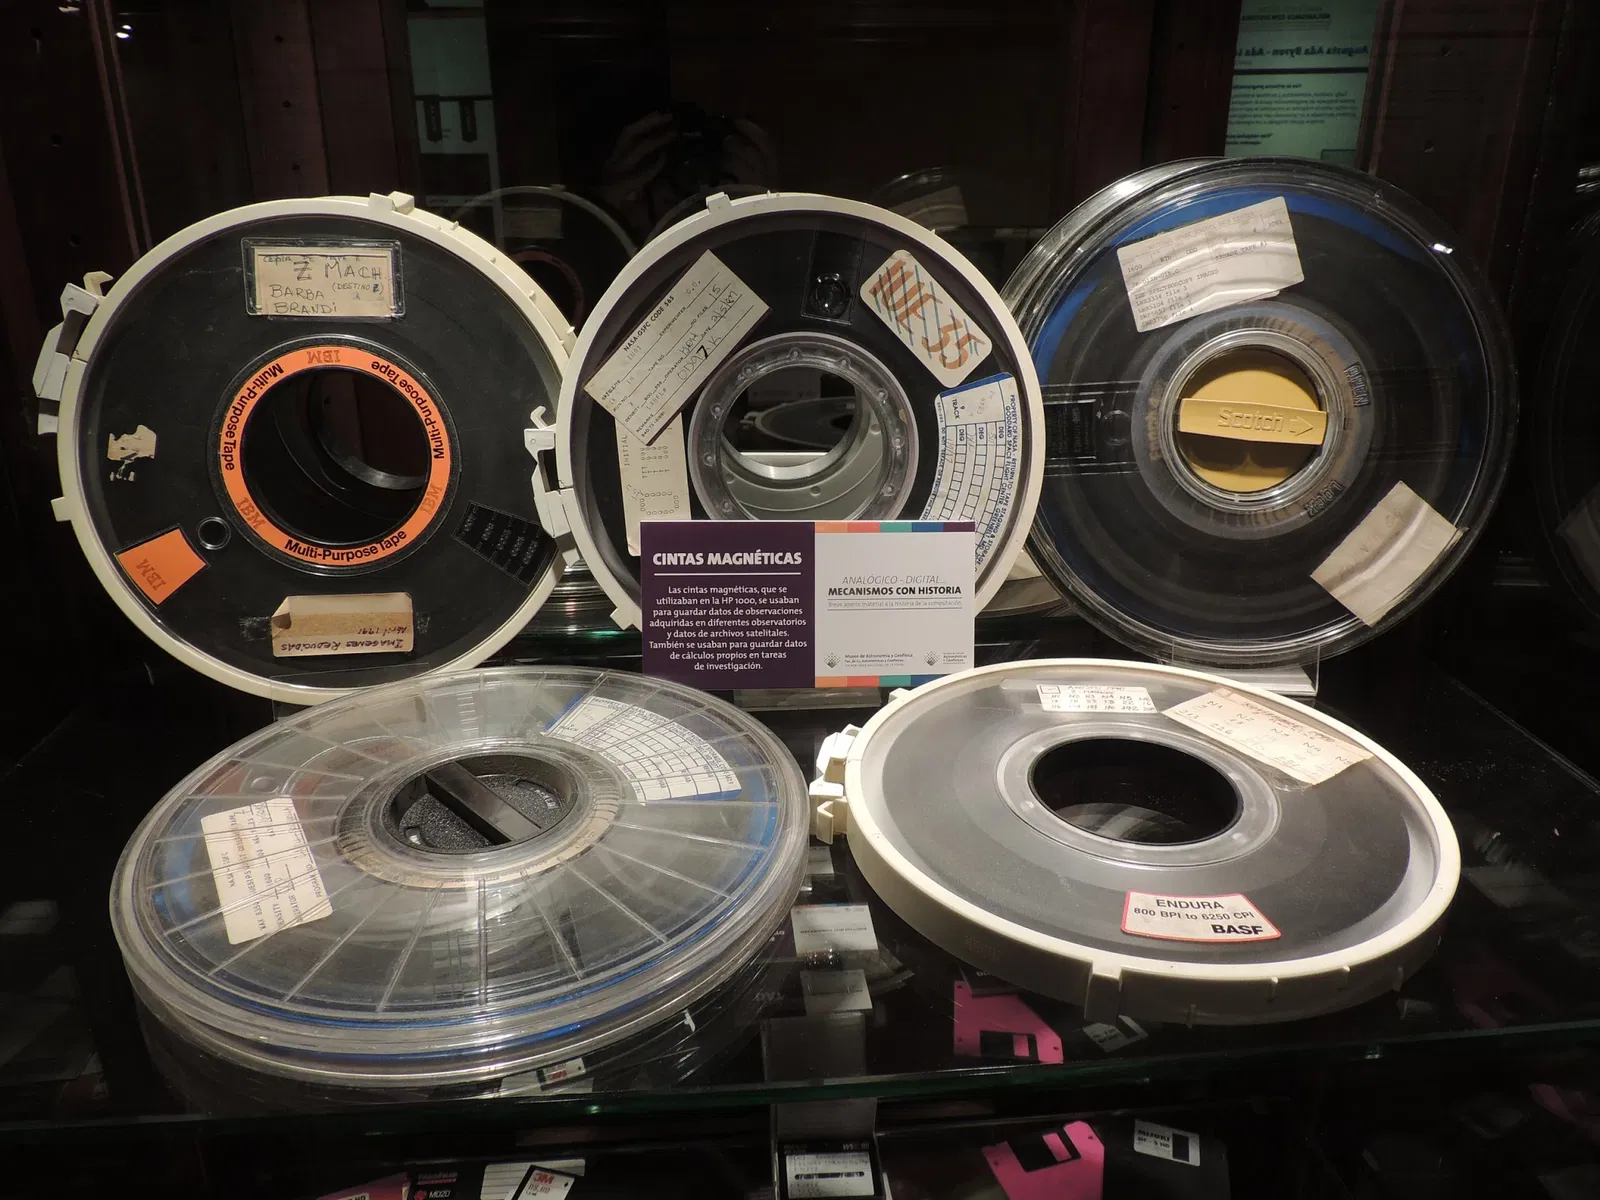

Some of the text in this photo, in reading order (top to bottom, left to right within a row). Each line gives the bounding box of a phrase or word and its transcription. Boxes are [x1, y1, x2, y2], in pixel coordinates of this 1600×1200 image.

[324, 260, 382, 280] MACH
[268, 283, 325, 300] BARBA
[623, 321, 652, 352] NASA-GSFC
[650, 308, 666, 322] CODE
[664, 295, 676, 308] 565
[306, 349, 342, 365] IBM
[663, 356, 685, 380] OPERATOR
[1344, 362, 1370, 408] OPEN
[221, 363, 285, 472] Multi-Purpose Tape
[370, 360, 446, 460] Multi-Purpose Tape
[952, 398, 960, 420] TRACK
[1009, 394, 1018, 425] PROPERTY
[1005, 405, 1013, 438] GODDARD
[1012, 424, 1018, 434] OF
[1217, 407, 1284, 433] Scotch
[1003, 460, 1011, 481] FLIGHT
[1010, 457, 1018, 480] RETURN
[419, 484, 443, 516] IBM
[1002, 492, 1012, 507] TAPE
[1303, 479, 1345, 518] LOCK
[235, 496, 267, 530] IBM
[992, 507, 1007, 534] STAGING
[283, 529, 408, 563] Multi-Purpose Tape
[976, 539, 994, 566] STORAGE
[652, 549, 803, 566] CINTAS MAGNÉTICAS
[136, 558, 167, 591] IBM
[841, 574, 898, 585] ANALÓGICO
[668, 586, 682, 594] Las
[683, 585, 708, 594] cintas
[710, 585, 760, 595] magnéticas,
[761, 587, 777, 595] que
[828, 586, 962, 596] MECANISMOS CON HISTORIA
[656, 596, 698, 605] utilizaban
[711, 597, 720, 605] la
[735, 598, 757, 606] 1000,
[769, 596, 800, 604] usaban
[653, 607, 803, 618] para guardar datos de observaciones
[649, 619, 694, 629] adquiridas
[707, 618, 750, 627] diferentes
[751, 618, 807, 627] observatorios
[666, 628, 790, 640] y datos de archivos satelitales.
[649, 641, 685, 649] También
[696, 640, 728, 648] usaban
[729, 642, 748, 650] para
[749, 640, 783, 650] guardar
[784, 639, 808, 648] datos
[669, 651, 680, 660] de
[681, 651, 715, 660] cálculos
[716, 651, 748, 661] propios
[761, 651, 787, 659] tareas
[694, 661, 764, 672] de investigación.
[1156, 898, 1225, 910] ENDURA
[1133, 907, 1255, 921] 800 BPI to 6250 CPI
[1211, 924, 1264, 935] BASF
[532, 1172, 555, 1184] 3M
